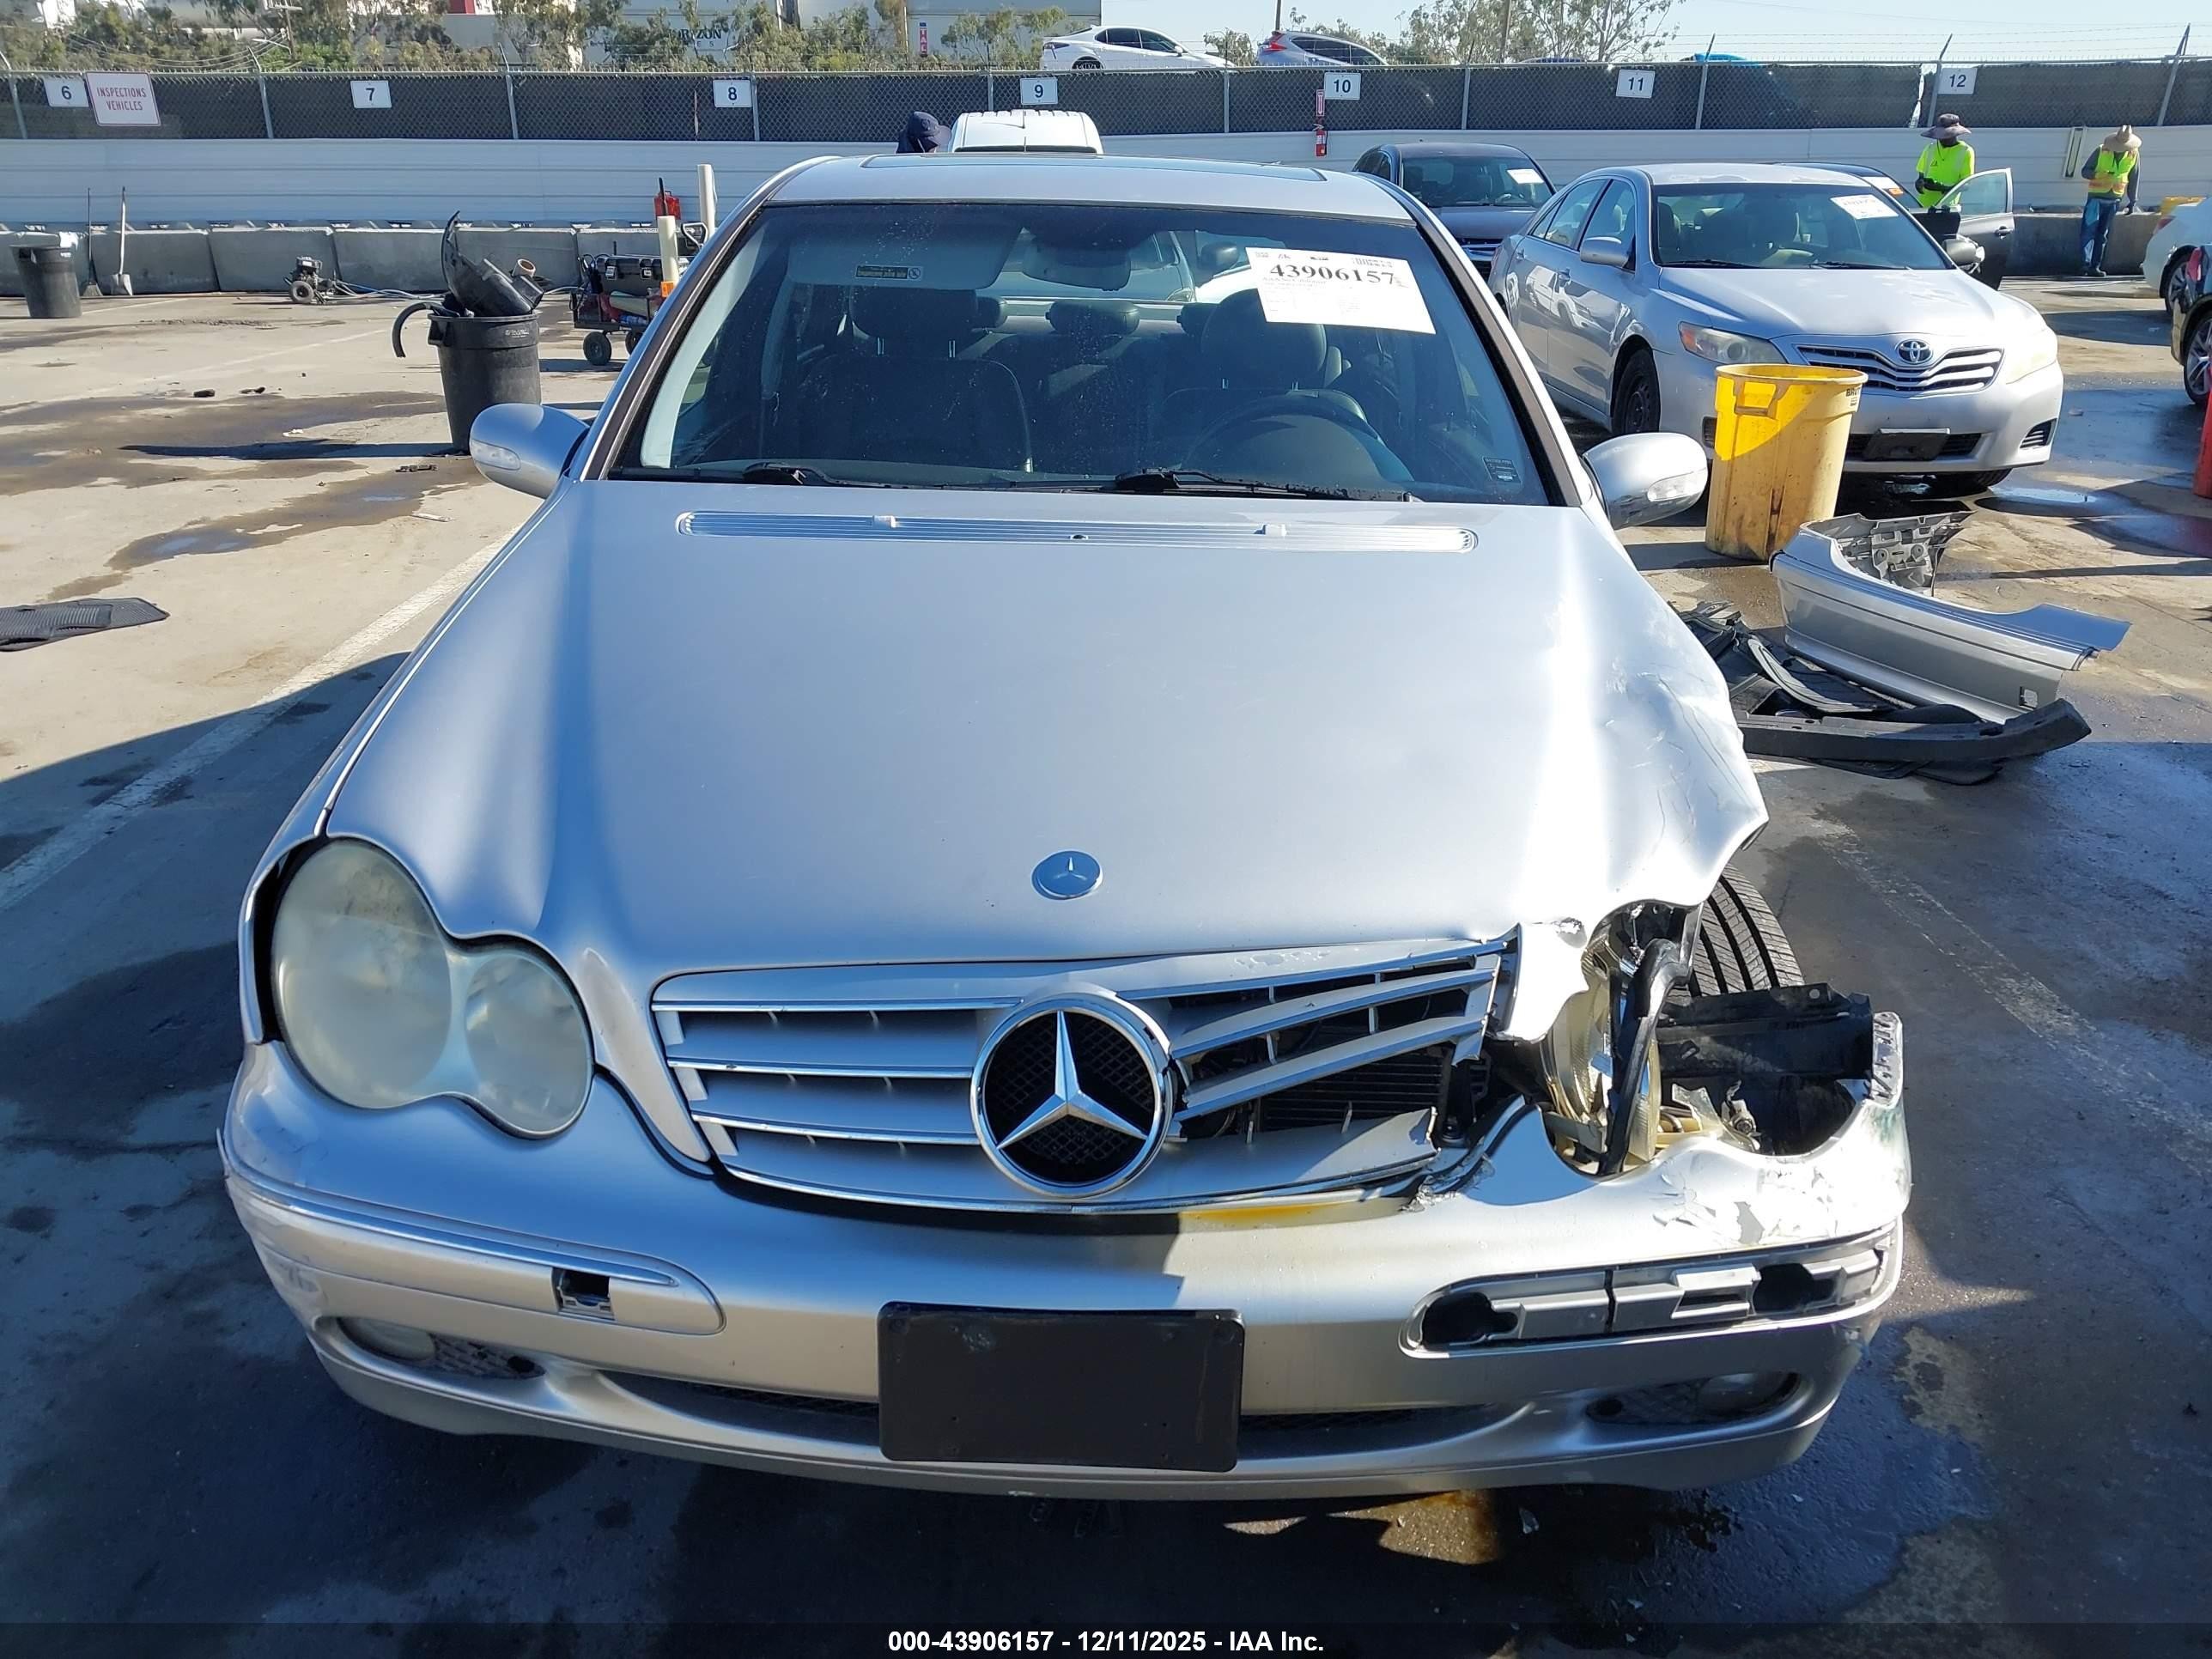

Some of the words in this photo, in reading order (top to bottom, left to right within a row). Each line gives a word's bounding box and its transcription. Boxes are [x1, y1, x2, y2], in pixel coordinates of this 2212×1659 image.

[1334, 79, 1351, 93] 10
[1628, 76, 1644, 91] 11
[1949, 74, 1966, 88] 12
[61, 86, 72, 100] 6
[96, 88, 147, 98] INSPECTIONS
[365, 88, 375, 101] 7
[728, 87, 738, 100] 8
[1034, 84, 1043, 98] 9
[106, 100, 143, 111] VEHICLES
[1269, 264, 1395, 285] 43906157
